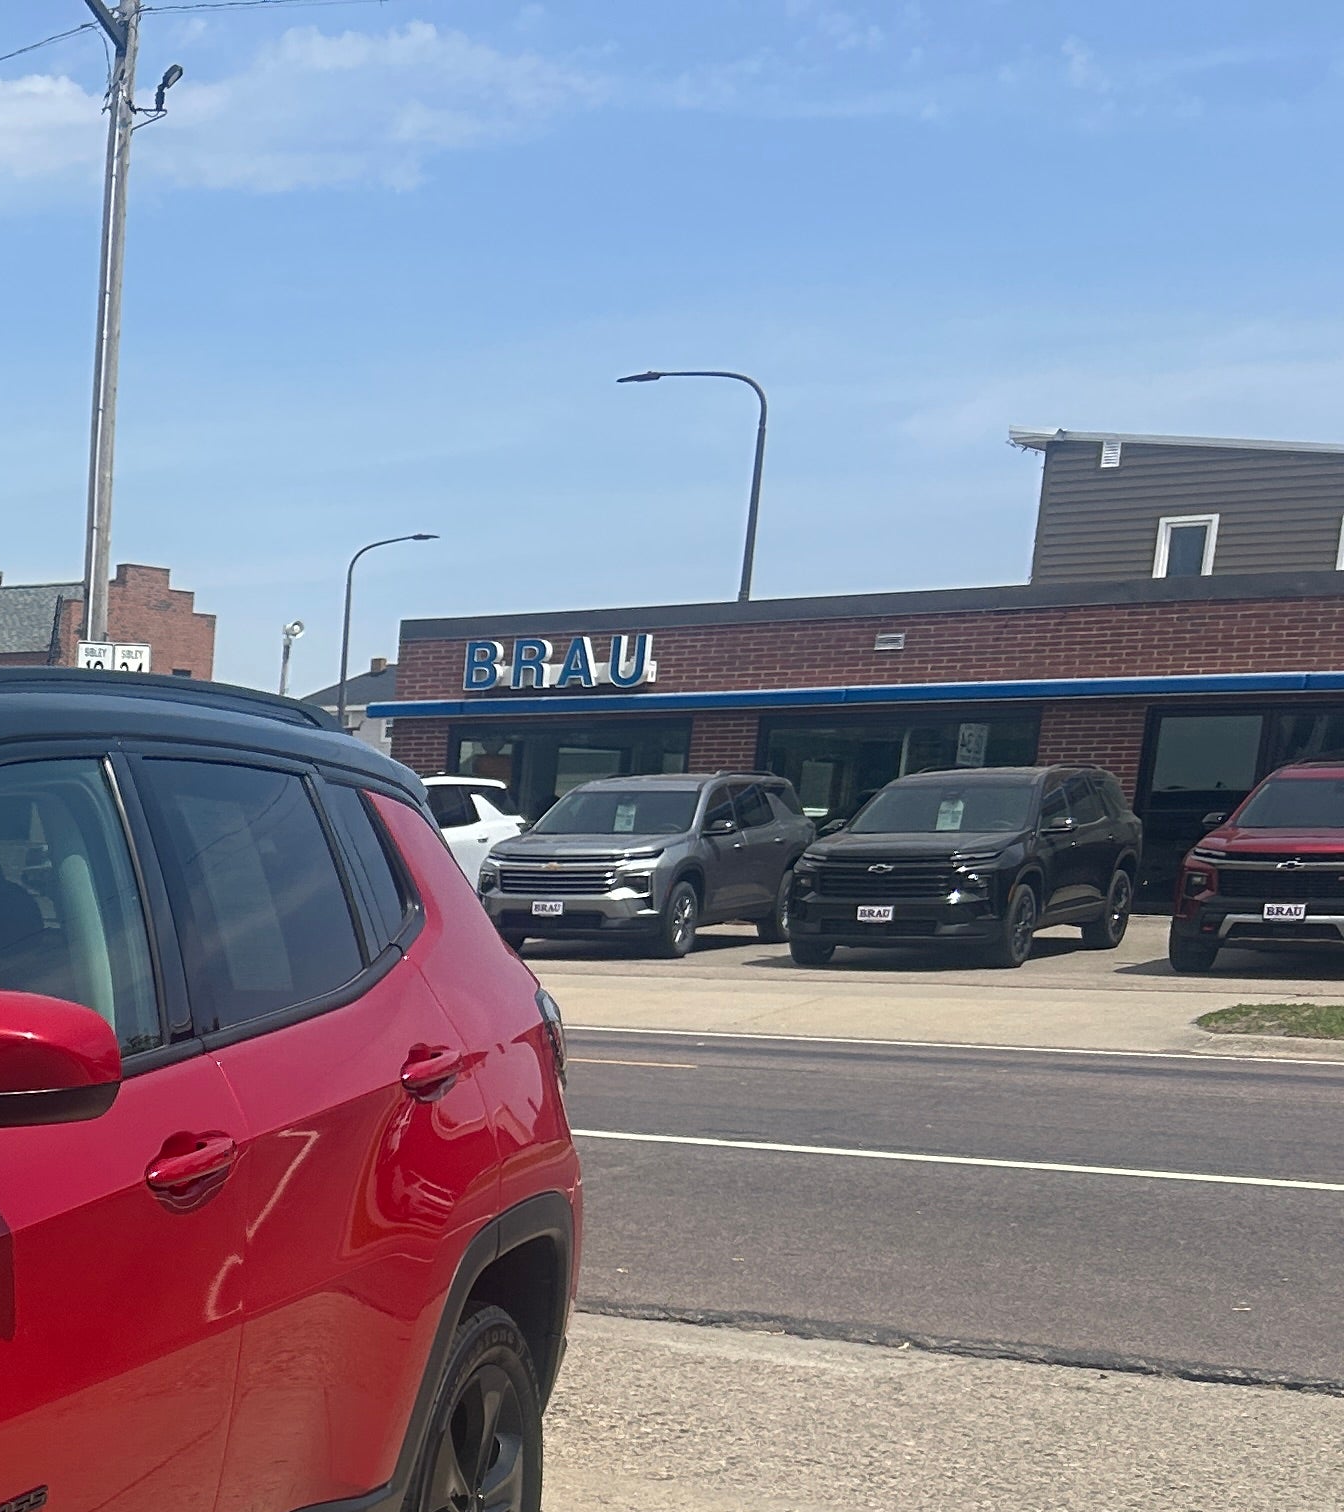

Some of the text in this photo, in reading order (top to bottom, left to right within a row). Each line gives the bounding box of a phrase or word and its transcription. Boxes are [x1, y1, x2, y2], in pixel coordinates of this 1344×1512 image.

[463, 633, 653, 691] BRAU
[534, 903, 561, 913] BRAU
[859, 908, 891, 918] BRAU
[1266, 906, 1302, 916] BRAU
